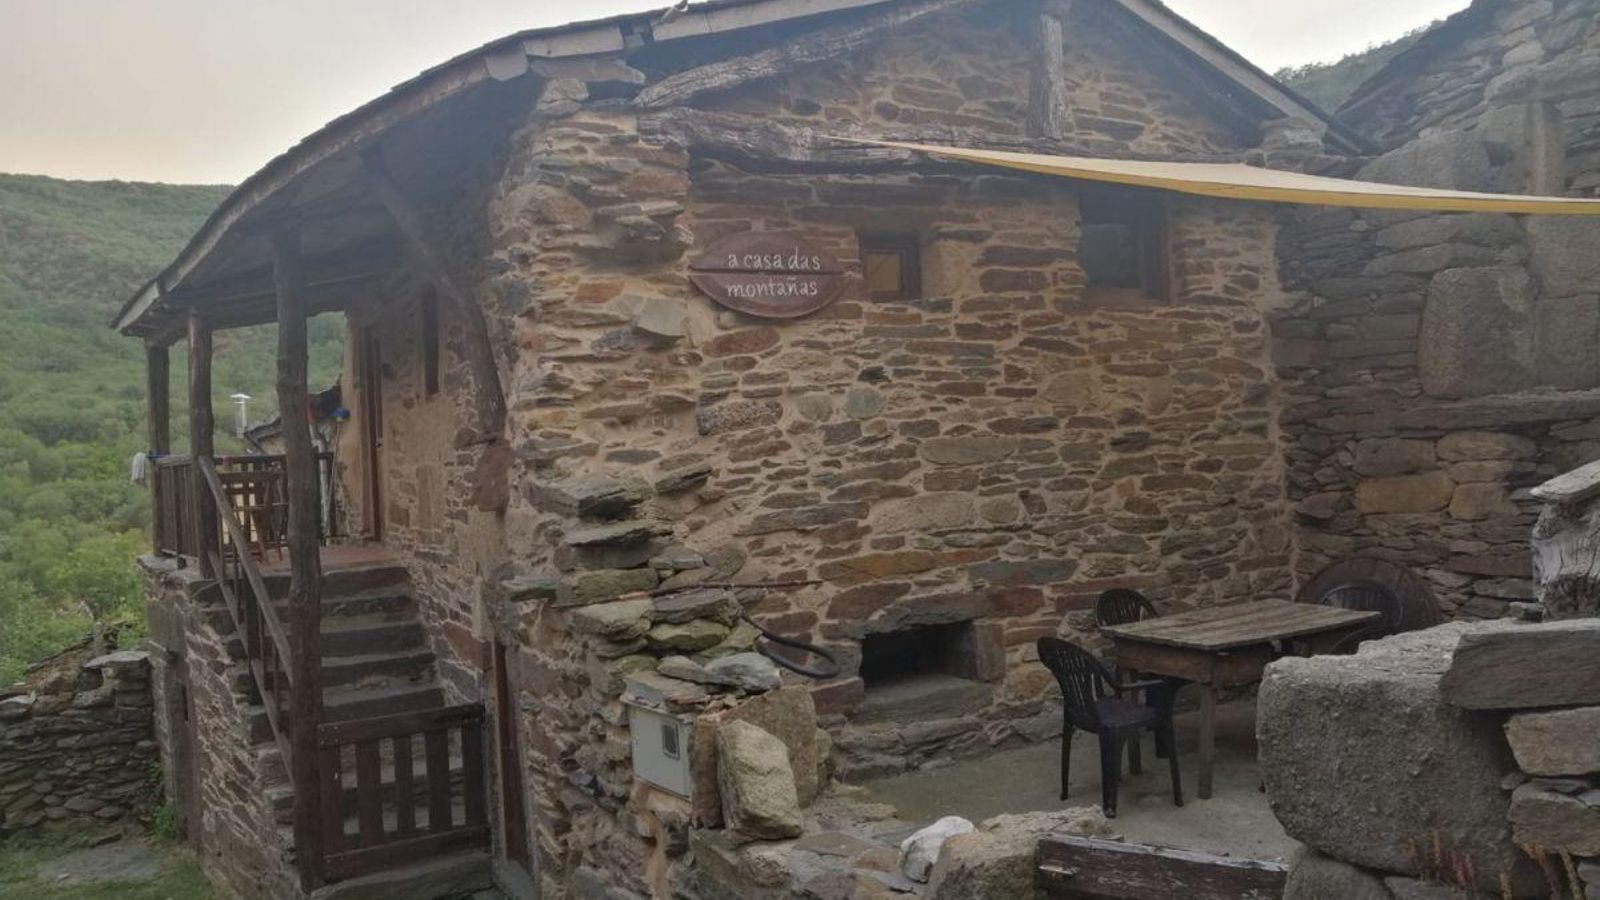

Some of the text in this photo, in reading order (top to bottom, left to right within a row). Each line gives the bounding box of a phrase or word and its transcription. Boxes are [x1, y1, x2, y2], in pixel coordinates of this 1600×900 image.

[728, 246, 821, 271] a casa das
[727, 276, 818, 297] montañas
